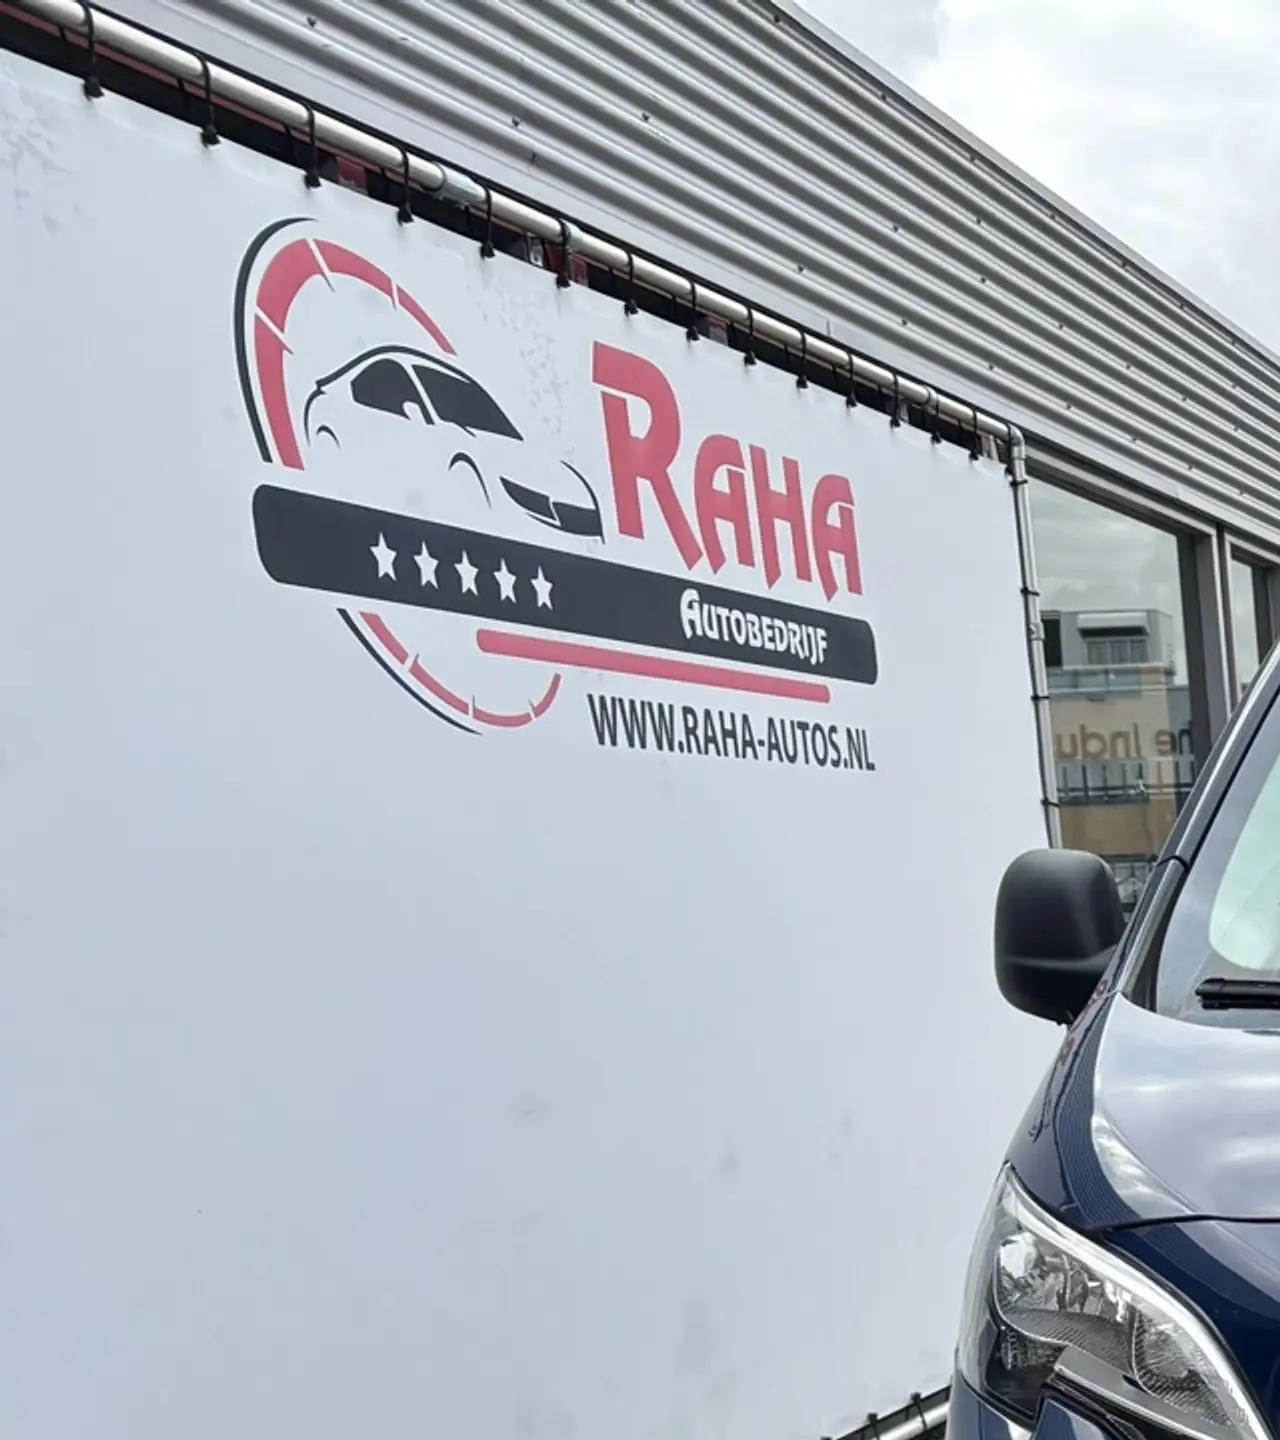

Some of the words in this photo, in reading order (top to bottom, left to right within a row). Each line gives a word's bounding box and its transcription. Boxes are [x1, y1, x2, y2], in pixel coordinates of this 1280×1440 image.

[592, 340, 863, 602] RAHA
[680, 588, 828, 666] AUTOBEDRIJF
[588, 693, 876, 771] WWW.RAHA-AUTOS.NL
